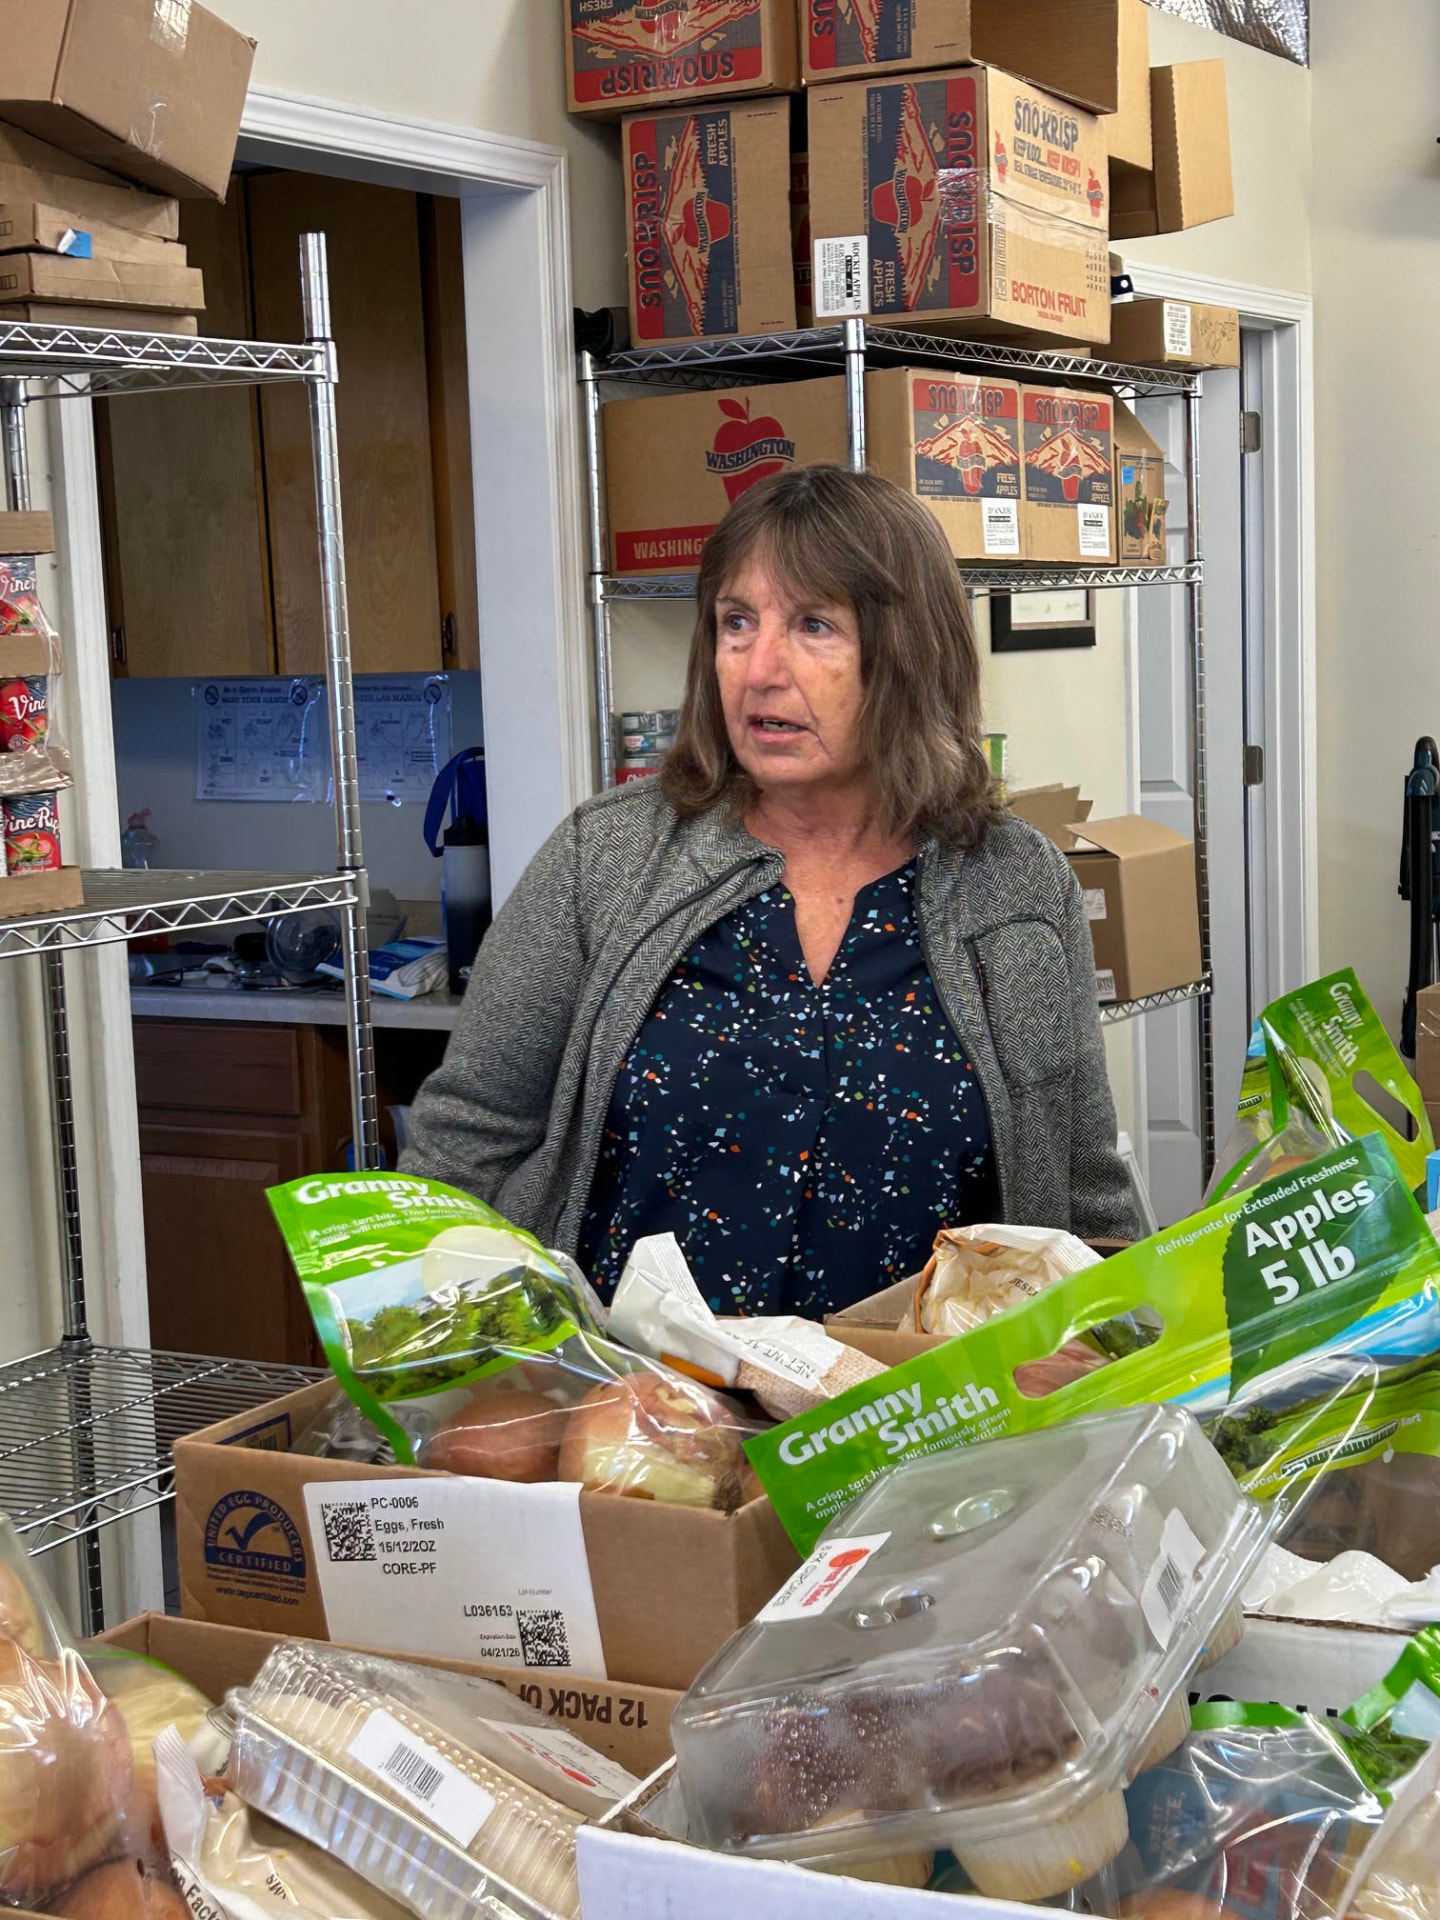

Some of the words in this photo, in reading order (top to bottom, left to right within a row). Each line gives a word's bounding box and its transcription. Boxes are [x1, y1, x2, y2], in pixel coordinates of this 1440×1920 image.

[579, 0, 614, 12] FRESH
[706, 122, 718, 166] FRESH
[717, 117, 729, 167] APPLES
[693, 191, 711, 255] WASHINGTON
[894, 168, 911, 234] WASHINGTON
[873, 257, 885, 308] APPLES
[884, 260, 896, 304] FRESH
[1012, 280, 1056, 311] BORTON
[1057, 292, 1087, 318] FRUIT
[705, 437, 796, 471] WASHINGTON
[634, 538, 708, 560] WASHING
[1329, 981, 1364, 1030] Granny
[1321, 1015, 1360, 1068] Smith
[297, 1179, 430, 1205] Granny
[1156, 1219, 1225, 1256] Refrigerate
[1224, 1207, 1243, 1226] for
[1243, 1180, 1300, 1215] Extended
[1299, 1155, 1360, 1188] Freshness
[1245, 1178, 1376, 1257] Apples
[1260, 1259, 1300, 1305] 5
[1299, 1238, 1356, 1289] lb
[778, 1381, 922, 1466] Granny
[878, 1382, 1000, 1455] Smith
[1400, 1412, 1423, 1428] Tart
[806, 1502, 815, 1512] A
[816, 1489, 849, 1508] crisp,
[848, 1475, 871, 1490] tart
[923, 1425, 977, 1451] famously
[978, 1408, 1011, 1428] green
[228, 1493, 252, 1508] EGG
[206, 1503, 227, 1547] UNITED
[255, 1495, 305, 1563] PRODUCERS
[375, 1518, 409, 1534] Eggs,
[411, 1516, 445, 1530] Fresh
[219, 1552, 292, 1573] CERTIFIED
[382, 1562, 437, 1575] CORE-PF
[548, 1688, 612, 1725] PACK
[617, 1699, 650, 1730] 12
